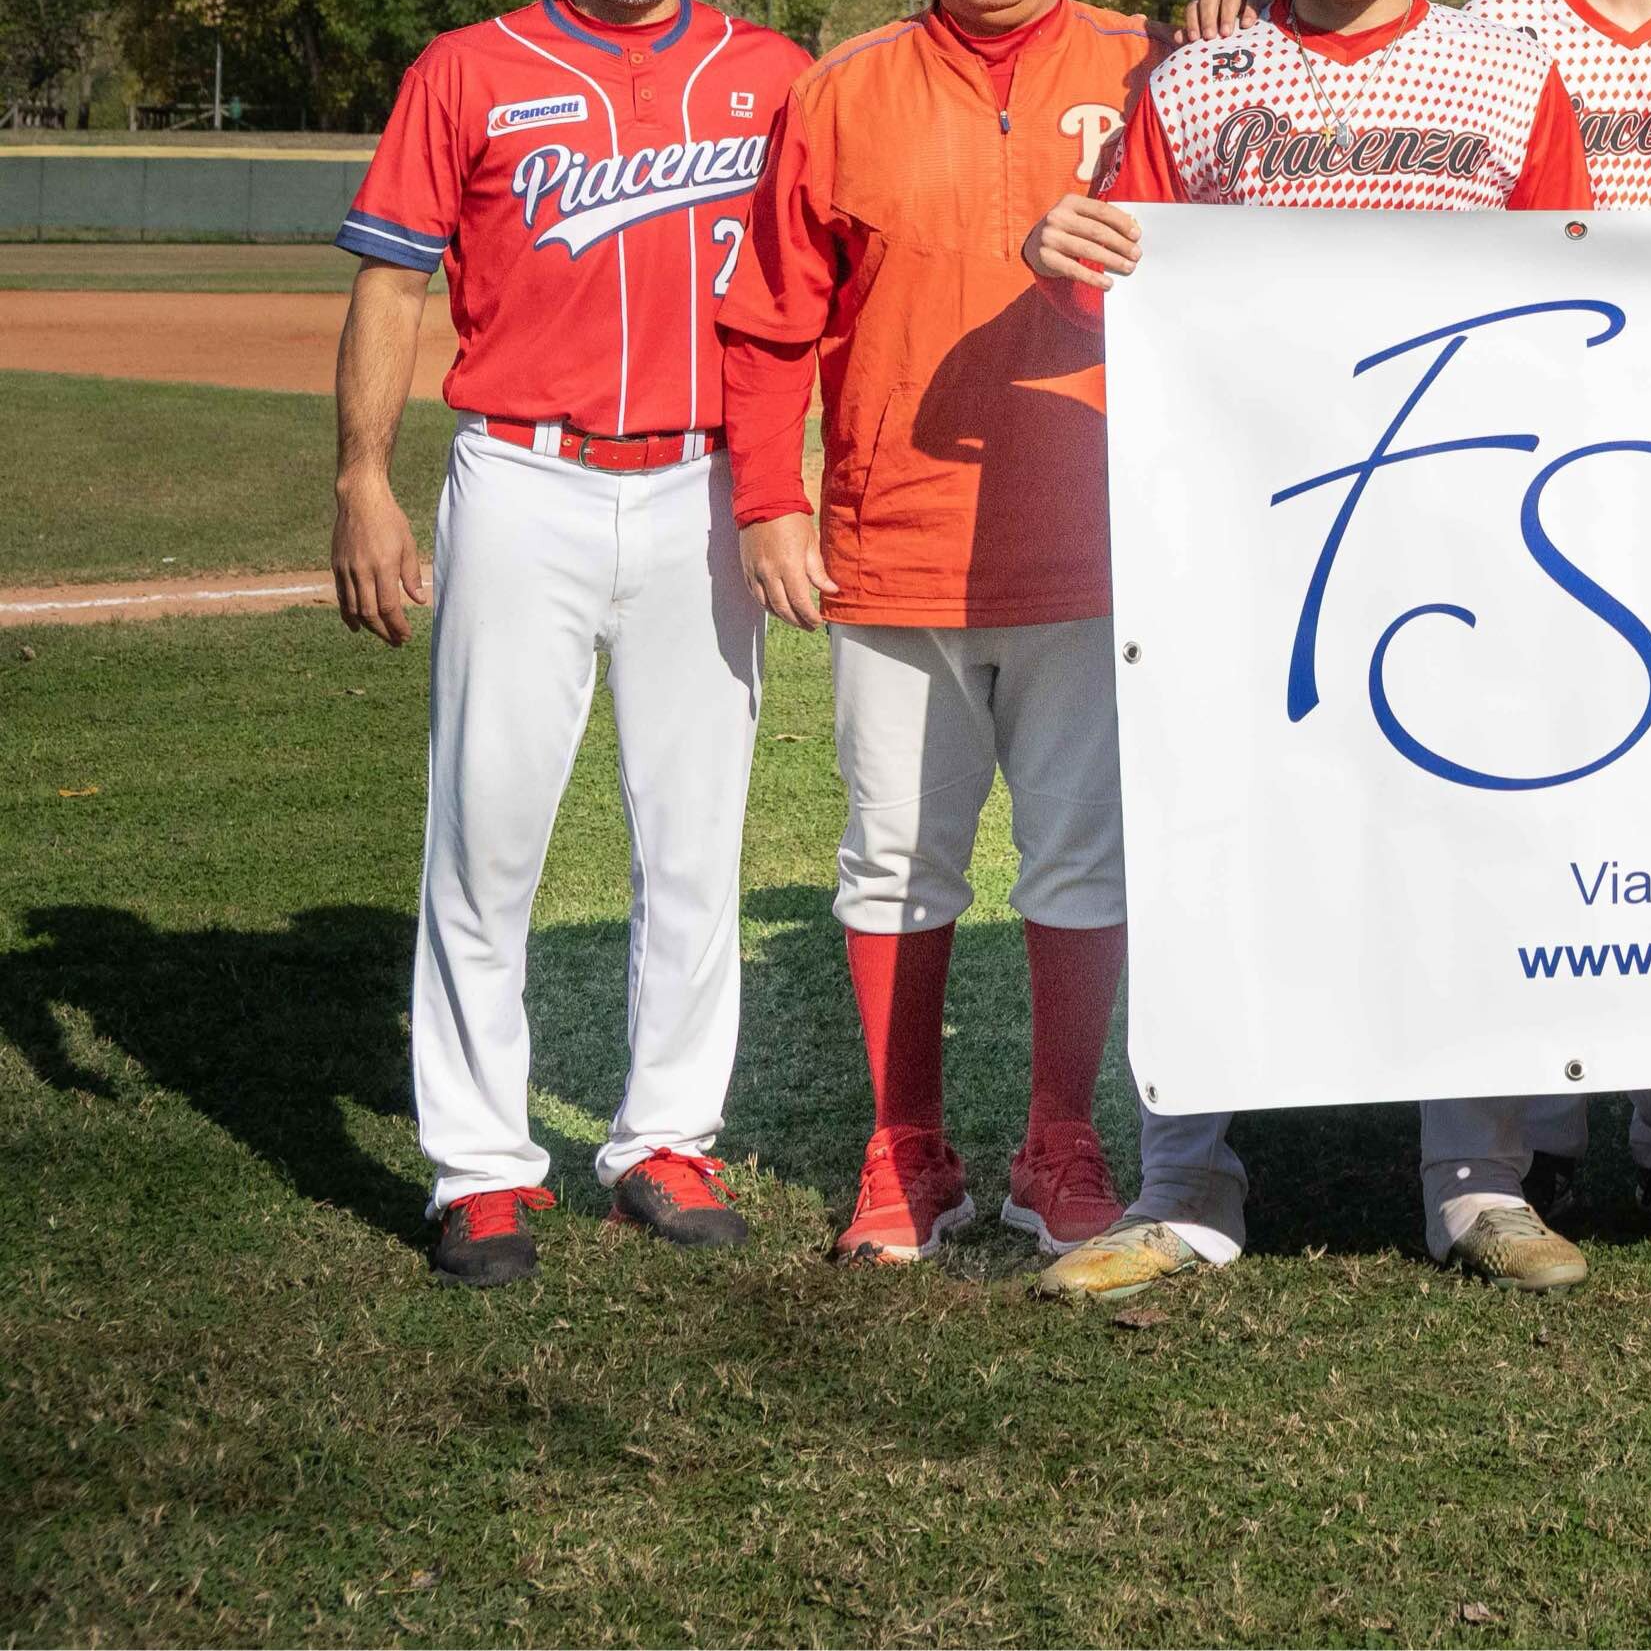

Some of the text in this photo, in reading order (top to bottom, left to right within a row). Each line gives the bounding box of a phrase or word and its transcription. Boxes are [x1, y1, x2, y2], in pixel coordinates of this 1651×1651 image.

[509, 101, 580, 122] Pancotti
[1057, 101, 1127, 185] P
[1215, 105, 1491, 196] Piacenza
[511, 134, 769, 230] Piacenza
